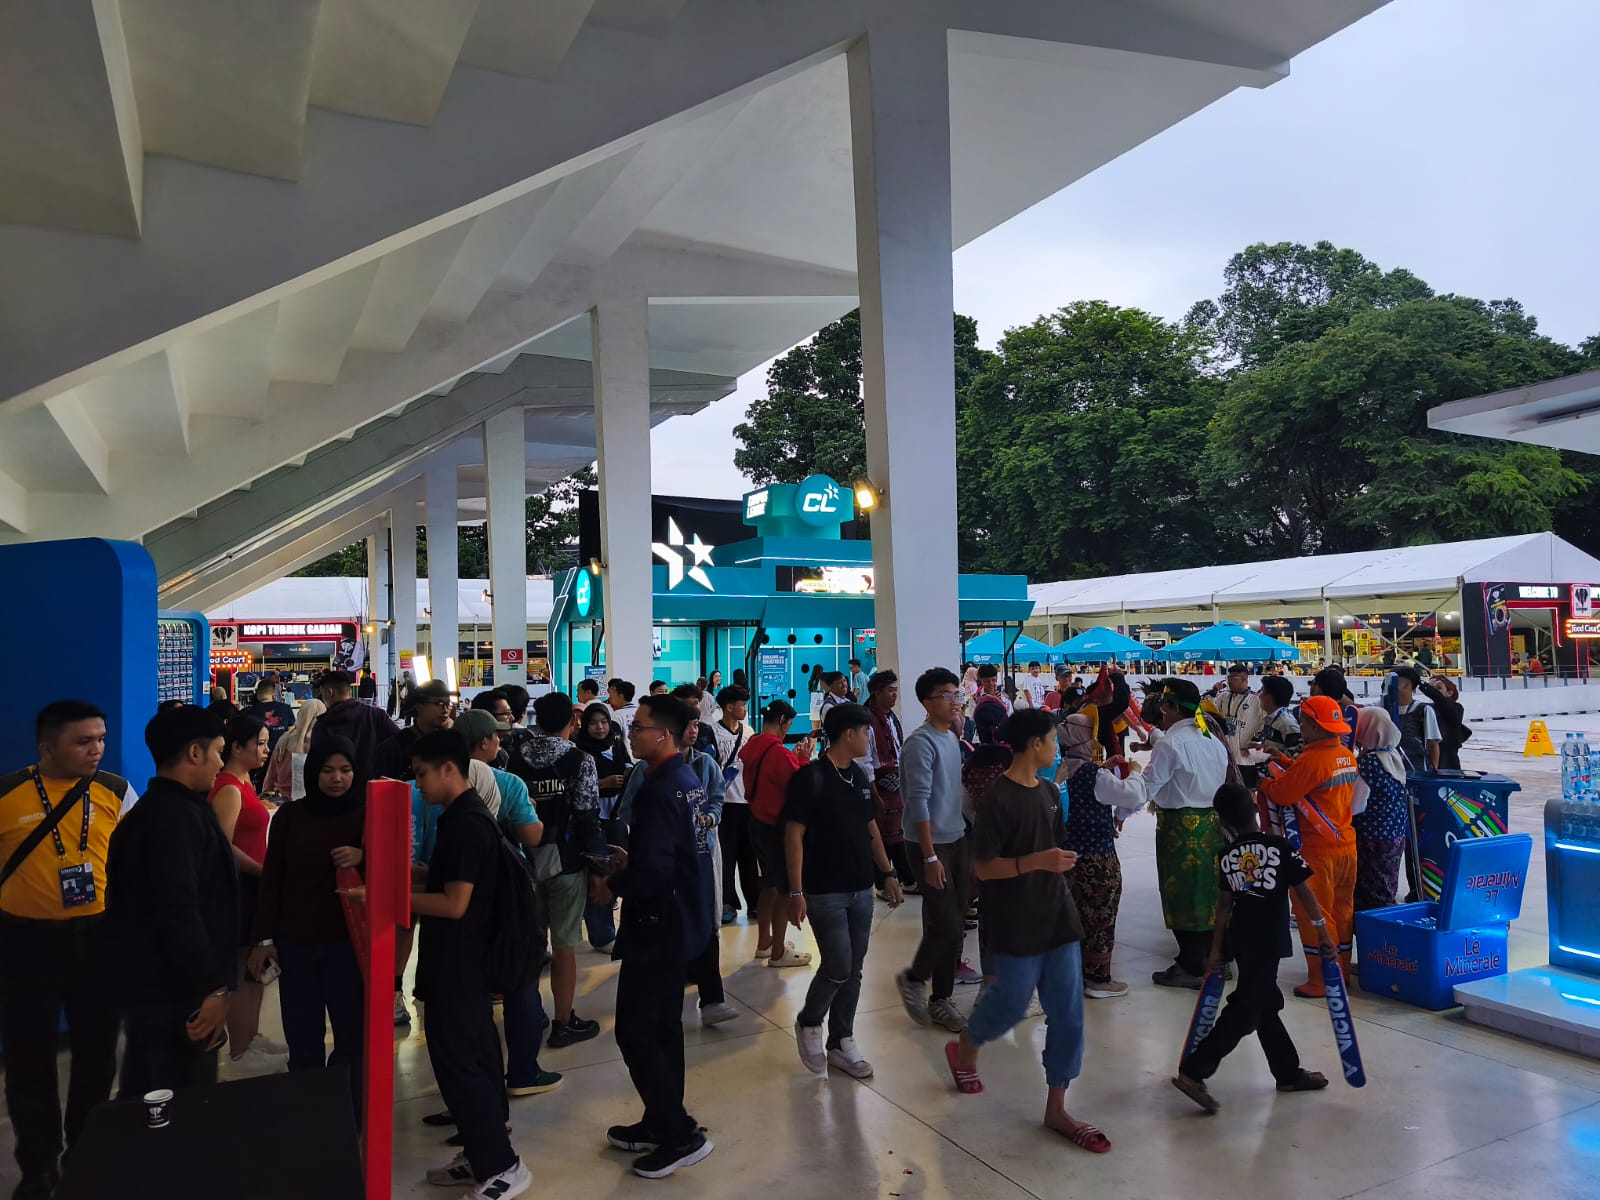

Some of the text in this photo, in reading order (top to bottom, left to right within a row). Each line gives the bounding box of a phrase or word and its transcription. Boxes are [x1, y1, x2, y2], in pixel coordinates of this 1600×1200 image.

[802, 493, 837, 512] CL
[243, 624, 266, 635] KOPI
[1571, 624, 1584, 632] Food
[1465, 871, 1521, 890] Minerale
[1484, 889, 1499, 906] Le
[1382, 939, 1398, 955] Le
[1465, 936, 1480, 956] Le
[1366, 950, 1418, 973] Minerale
[1445, 951, 1500, 977] Minerale
[1324, 984, 1353, 1051] VICTOR
